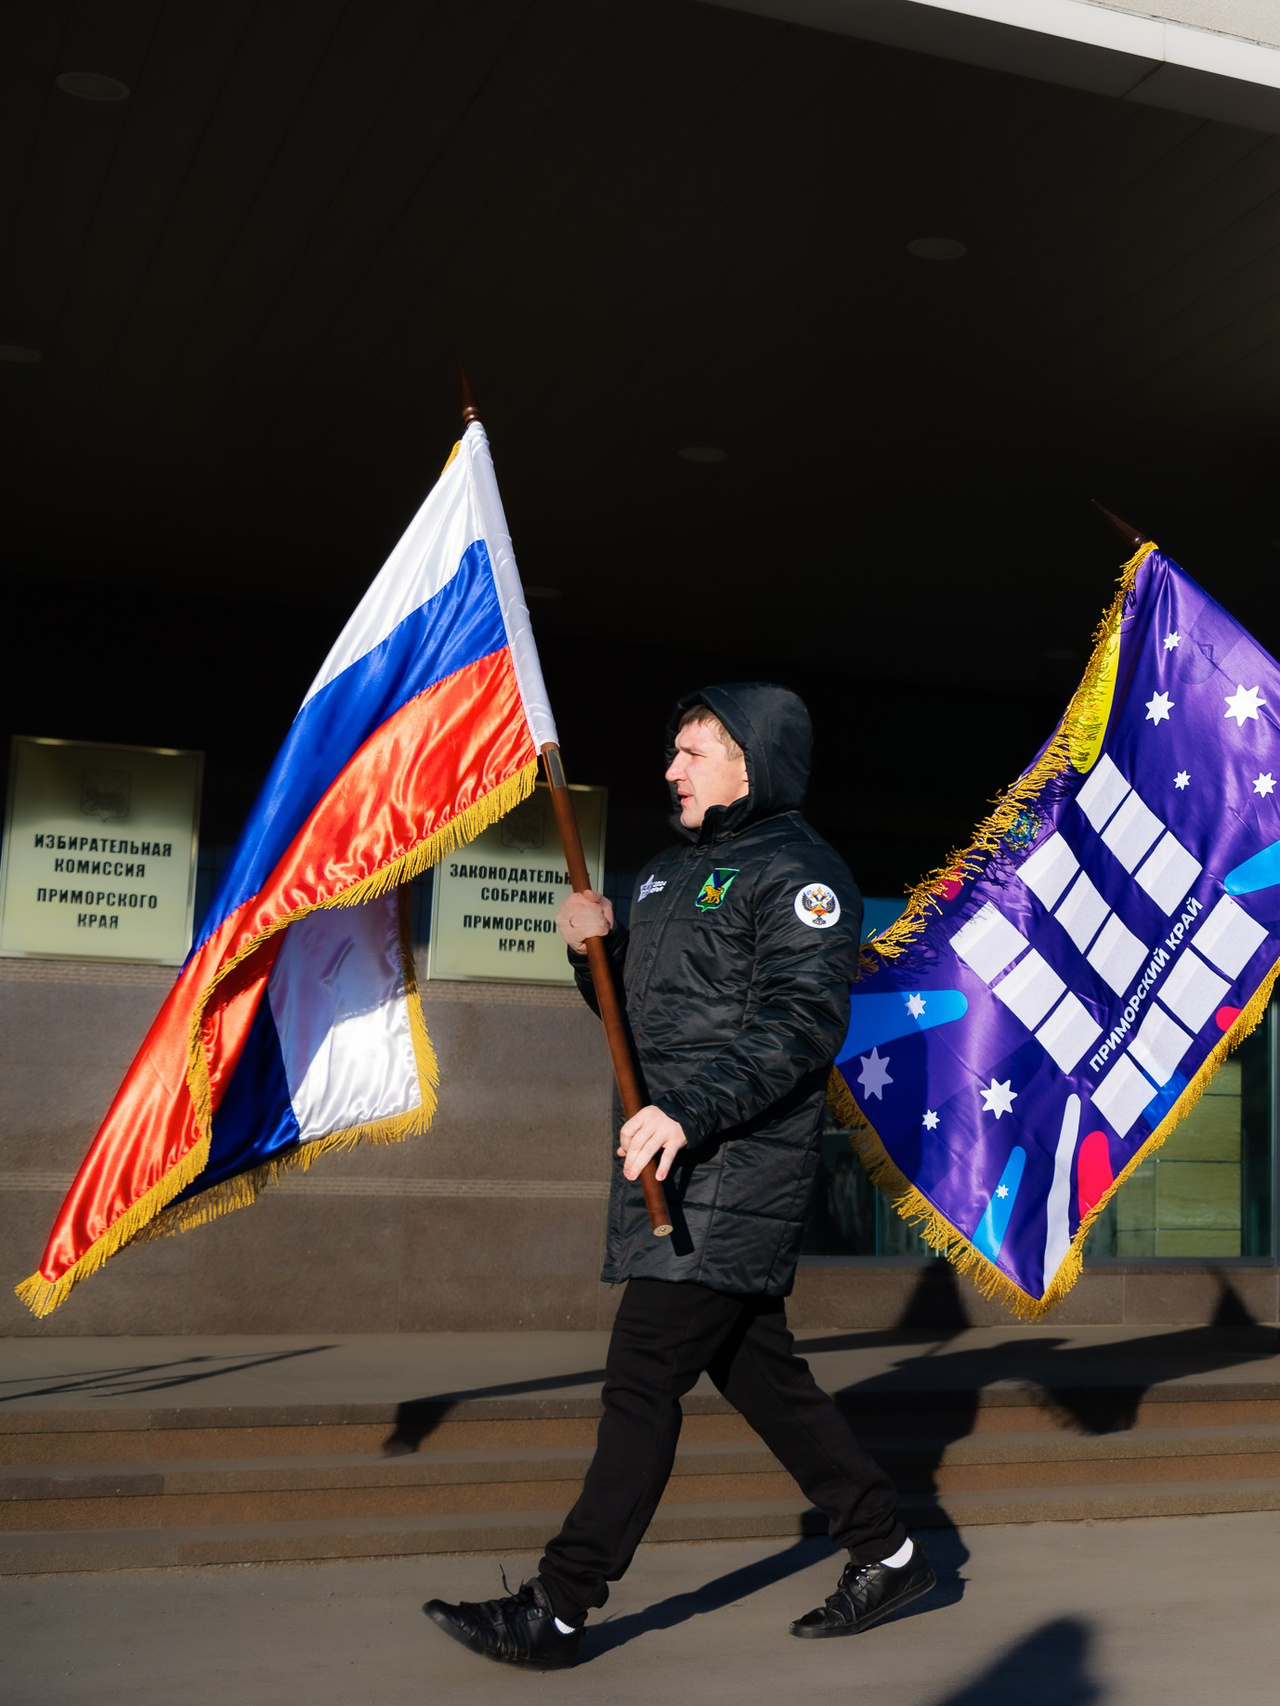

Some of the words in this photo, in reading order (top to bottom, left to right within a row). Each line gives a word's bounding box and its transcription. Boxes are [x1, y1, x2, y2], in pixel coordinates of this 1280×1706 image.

[34, 833, 173, 857] ИЗБИРАТЕЛЬНАЯ
[54, 858, 146, 878] КОМИССИЯ
[450, 863, 574, 885] ЗАКОНОДАТЕЛЬН
[37, 887, 158, 909] ПРИМОРСКОГО
[481, 887, 555, 905] СОБРАНИЕ
[77, 913, 119, 929] КРАЯ
[463, 914, 557, 933] ПРИМОРСКО
[499, 938, 535, 953] КРАЯ
[1089, 947, 1170, 1073] ПРИМОРСКИЙ
[1165, 897, 1204, 951] КРАЙ
